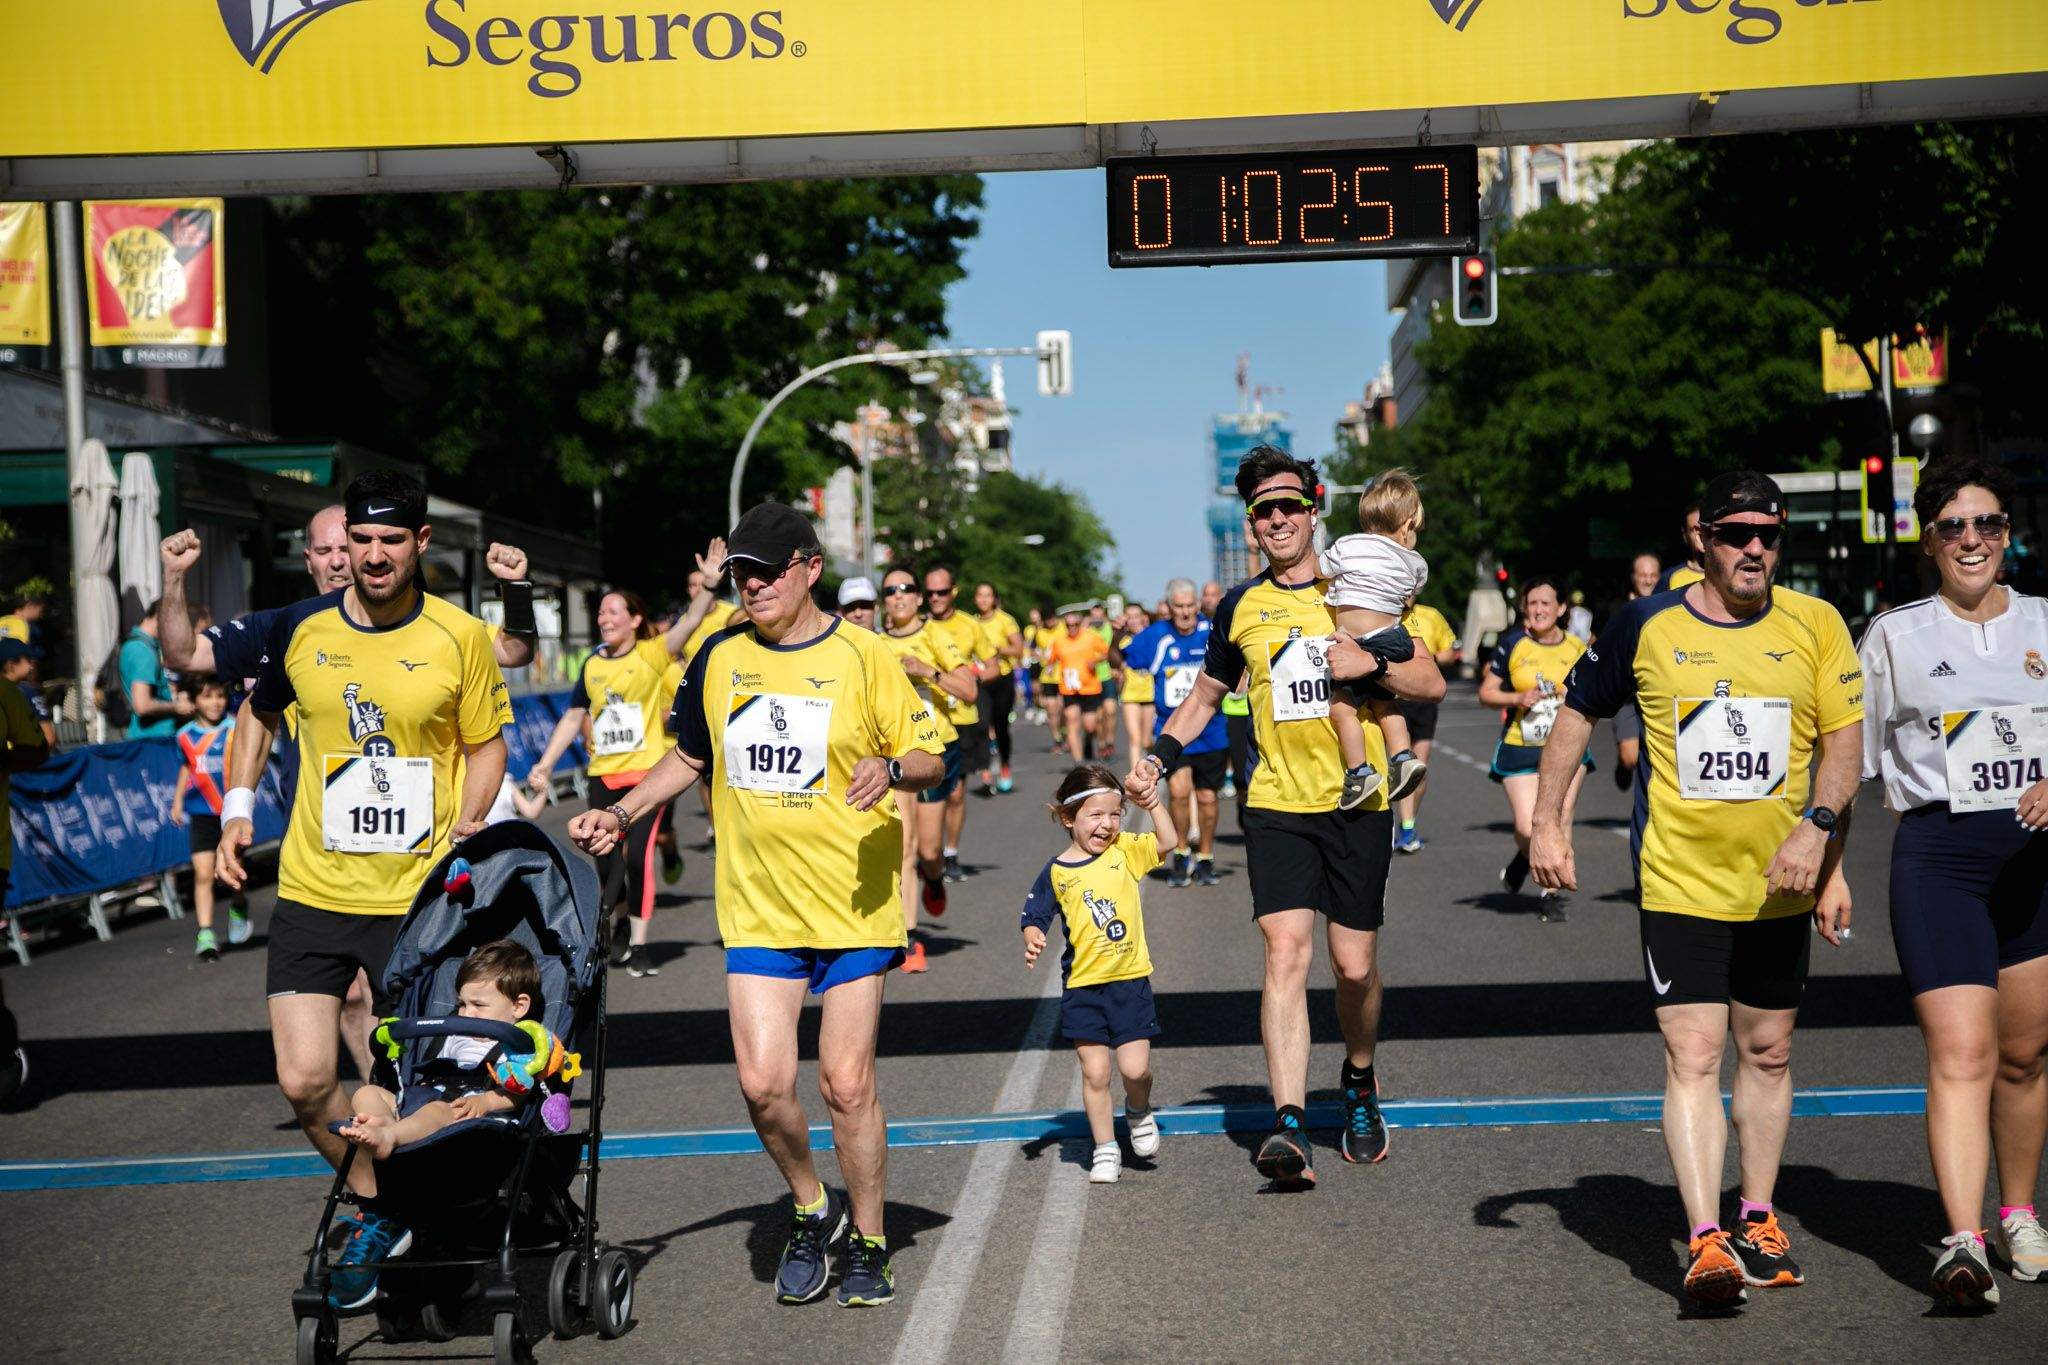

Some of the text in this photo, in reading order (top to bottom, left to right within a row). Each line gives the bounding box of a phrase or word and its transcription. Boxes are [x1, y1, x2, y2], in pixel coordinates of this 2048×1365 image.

[126, 230, 148, 247] LA
[108, 241, 169, 268] NOCHE
[118, 270, 138, 288] DE
[137, 347, 190, 363] MADRID
[1929, 669, 1957, 678] adidas
[1288, 678, 1330, 704] 190
[911, 709, 930, 723] Gén
[368, 743, 389, 758] 13
[745, 743, 803, 774] 1912
[1698, 751, 1771, 781] 2594
[1971, 757, 2046, 793] 3974
[781, 791, 813, 799] Carrera
[781, 799, 813, 811] Liberty
[348, 806, 406, 835] 1911
[1109, 923, 1124, 938] 13
